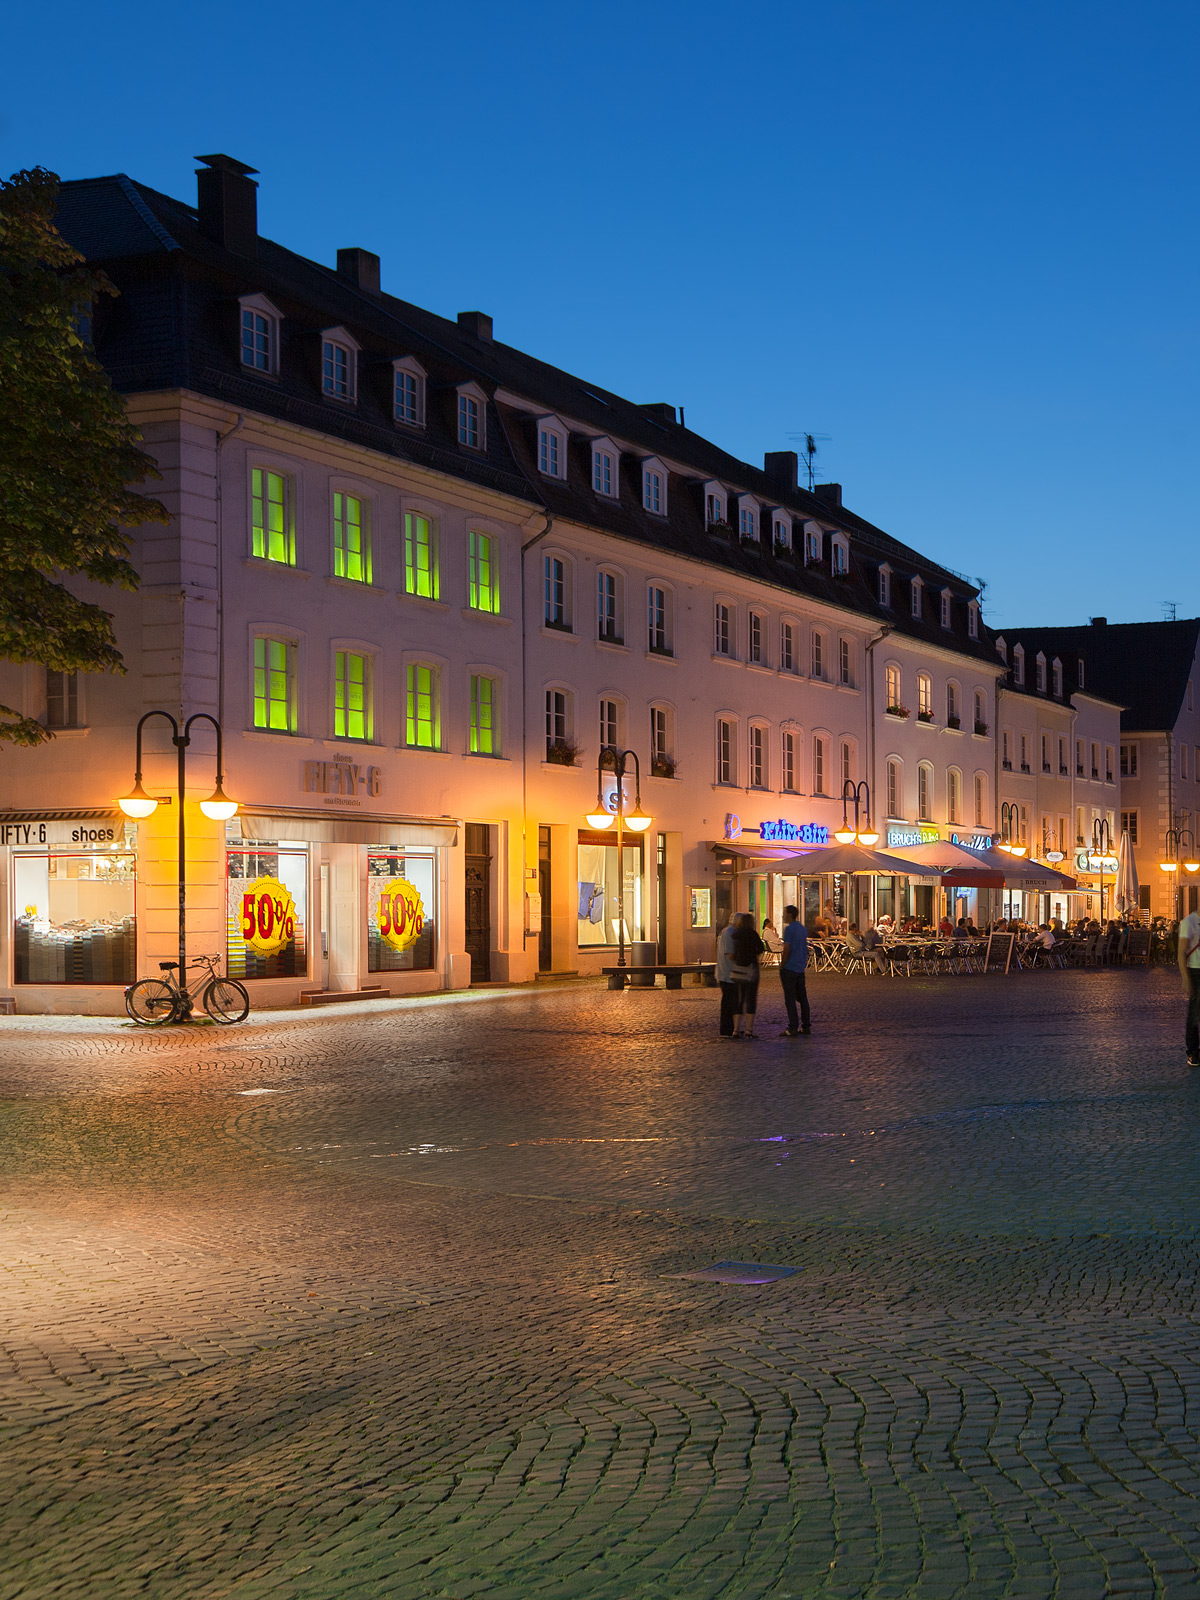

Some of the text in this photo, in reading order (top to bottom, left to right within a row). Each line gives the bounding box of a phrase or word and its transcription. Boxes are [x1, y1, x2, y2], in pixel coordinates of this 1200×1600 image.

[332, 752, 353, 763] shoes
[302, 760, 382, 797] FIFTY-6
[71, 826, 114, 842] shoes
[243, 894, 294, 941] 50%
[380, 893, 422, 937] 50%
